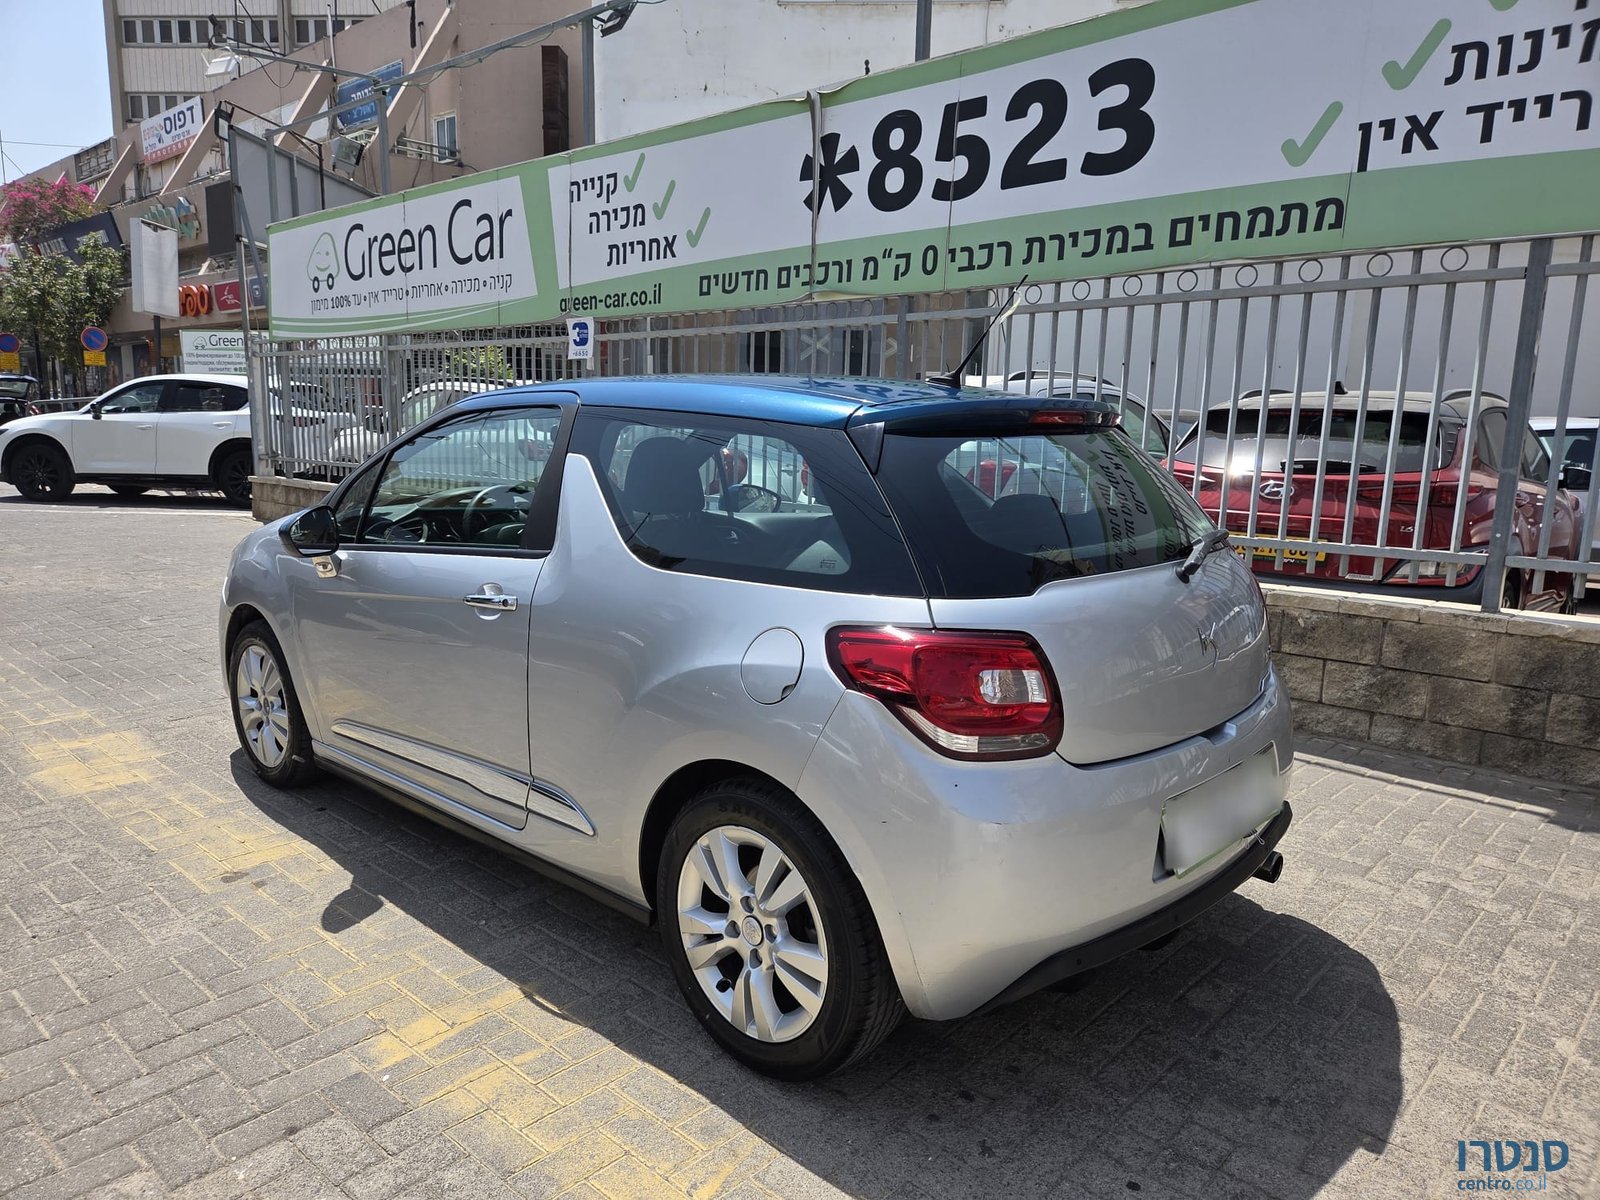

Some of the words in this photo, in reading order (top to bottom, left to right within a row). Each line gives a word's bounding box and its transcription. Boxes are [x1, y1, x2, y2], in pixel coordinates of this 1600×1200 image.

[163, 104, 195, 135] דפוס
[1357, 110, 1444, 173] אין
[569, 172, 618, 203] קנייה
[588, 203, 646, 235] מכירה
[1168, 197, 1345, 248] מתמחים
[344, 223, 437, 281] Green
[448, 198, 513, 265] Car
[606, 234, 678, 267] אחריות
[1022, 222, 1154, 265] במכירת
[922, 244, 939, 276] 0
[948, 241, 1013, 273] רכבי
[451, 277, 480, 295] מכירה
[489, 273, 512, 293] קניה
[699, 269, 769, 297] חדשים
[777, 259, 853, 289] ורכבים
[331, 294, 352, 309] 100%
[352, 294, 362, 306] עד
[368, 290, 380, 308] אין
[381, 287, 404, 302] טרייד
[411, 282, 443, 299] אחריות
[310, 298, 329, 316] מימון
[208, 334, 244, 347] Green
